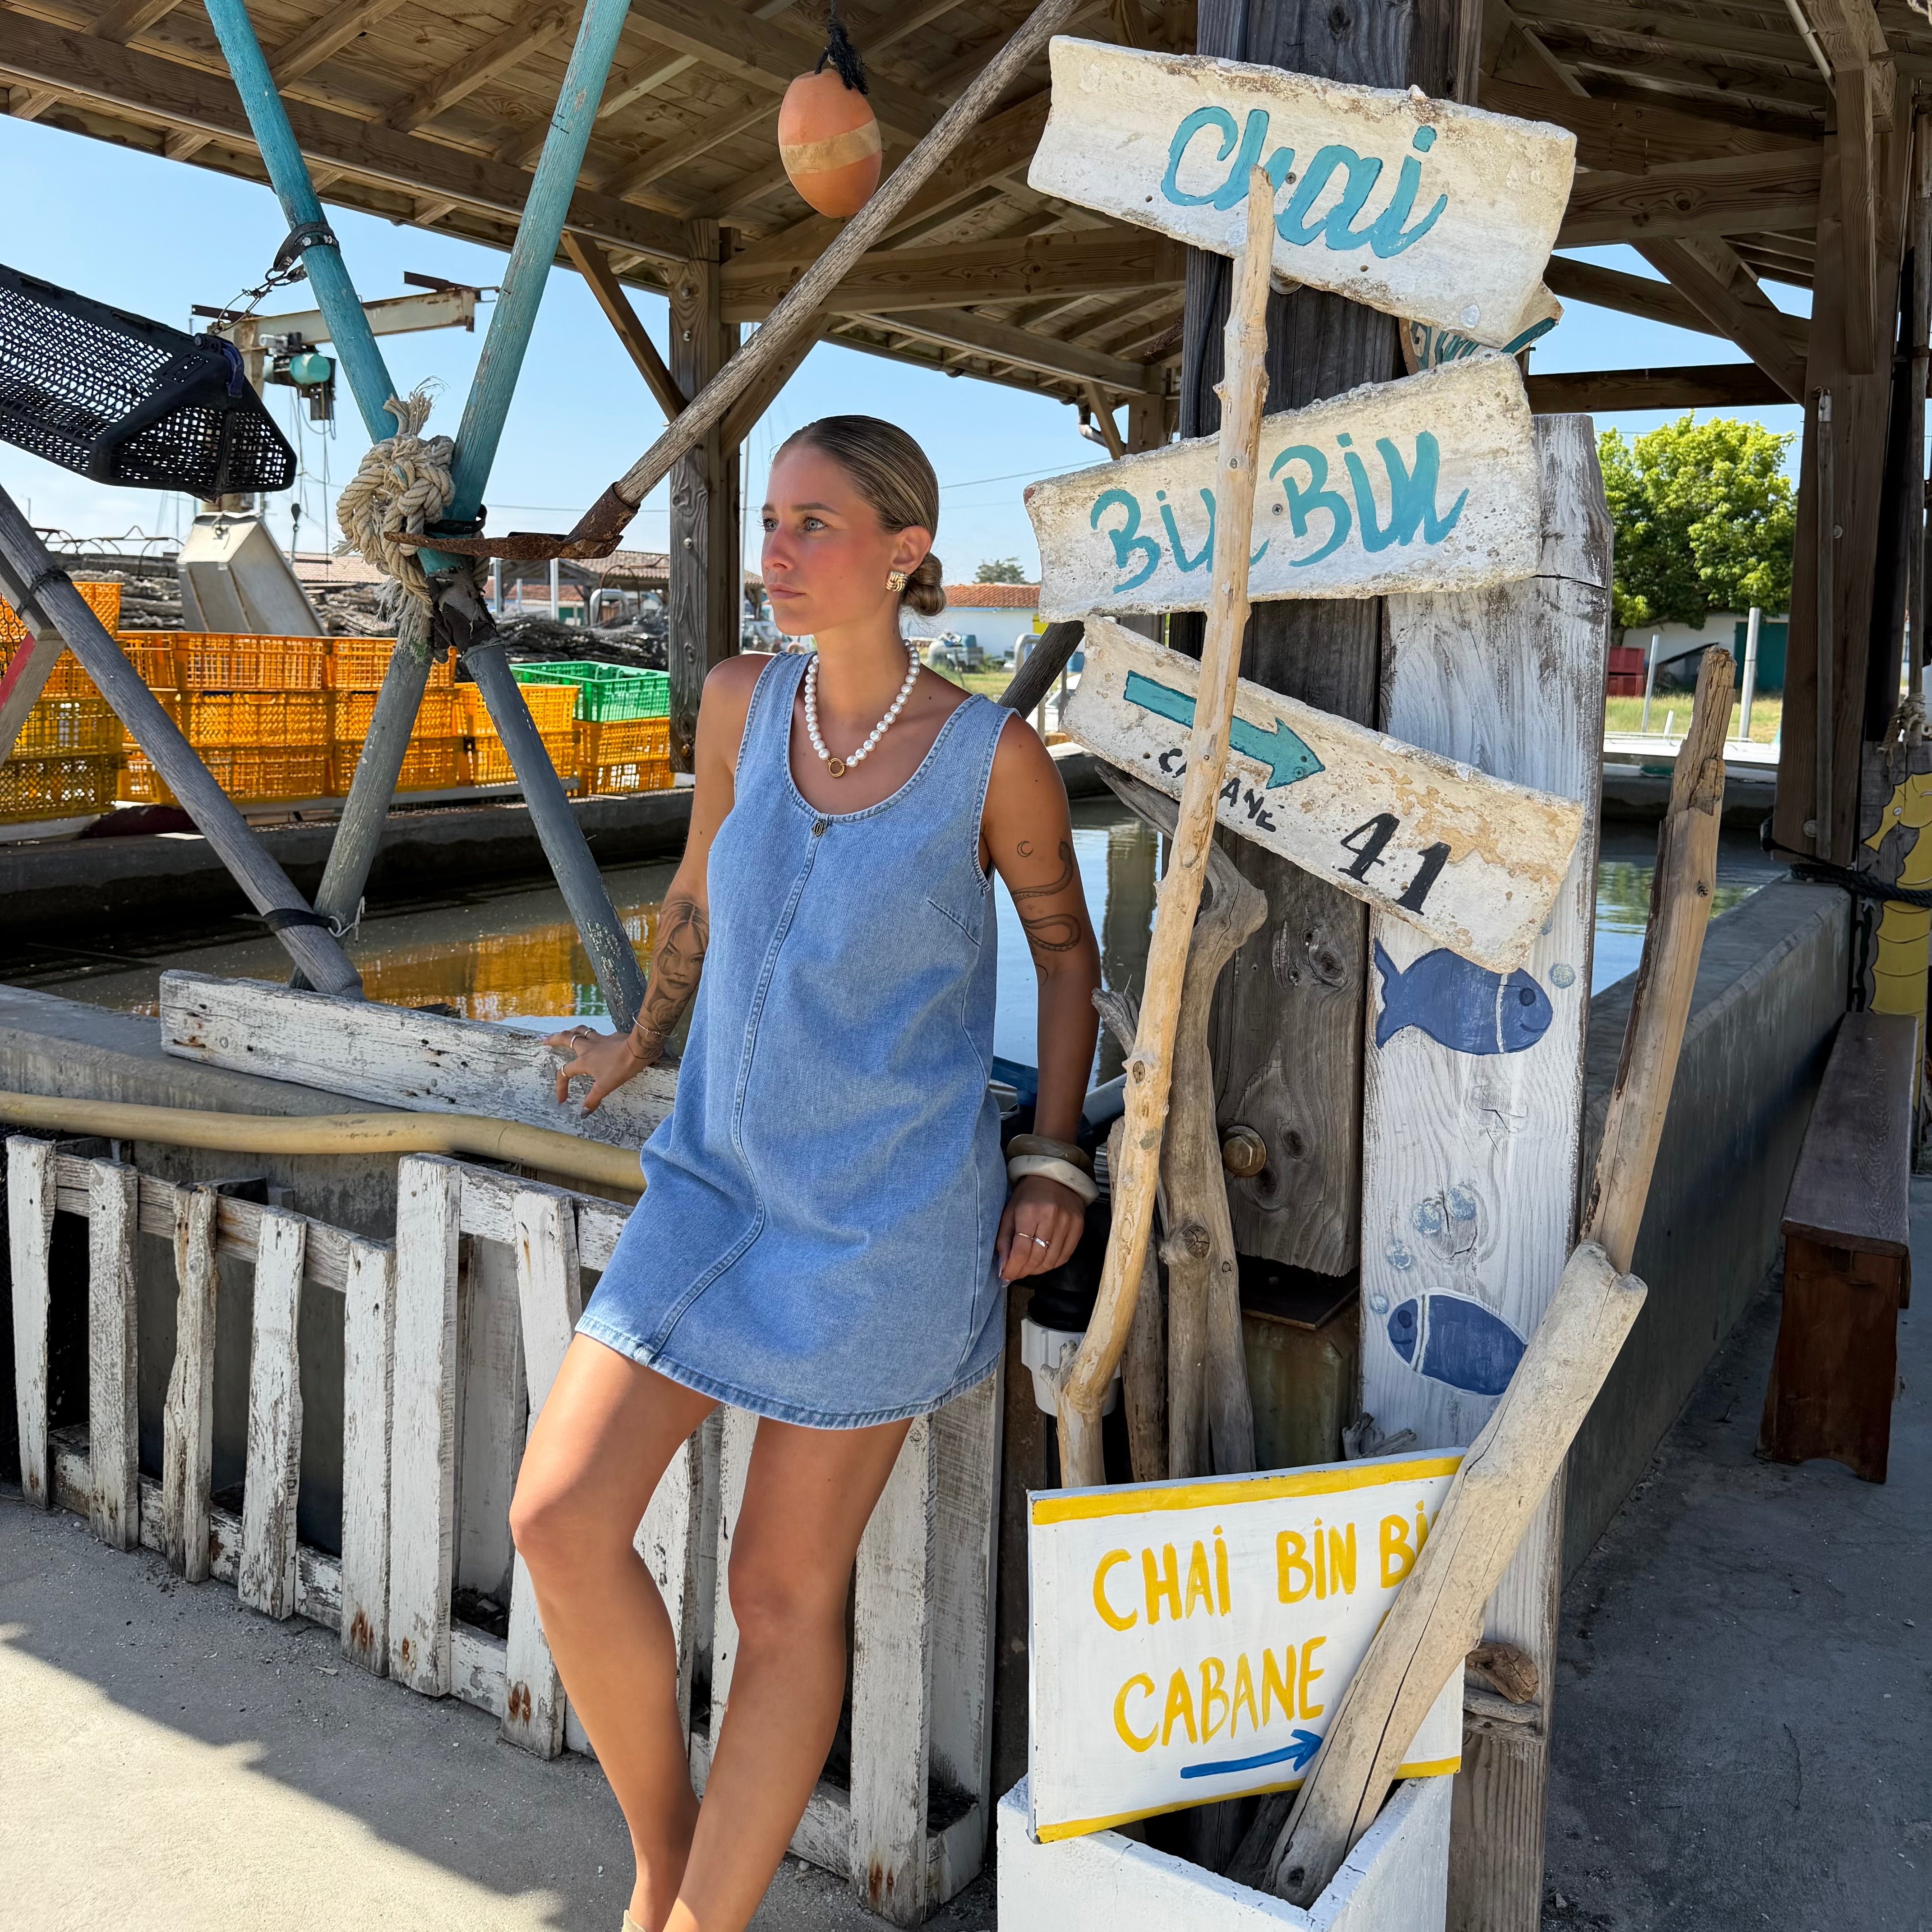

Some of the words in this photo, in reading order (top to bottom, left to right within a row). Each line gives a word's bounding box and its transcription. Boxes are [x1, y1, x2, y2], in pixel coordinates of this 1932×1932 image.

[1158, 748, 1276, 832] CANE
[1338, 812, 1451, 916] 41
[1113, 1636, 1327, 1752] CABANE
